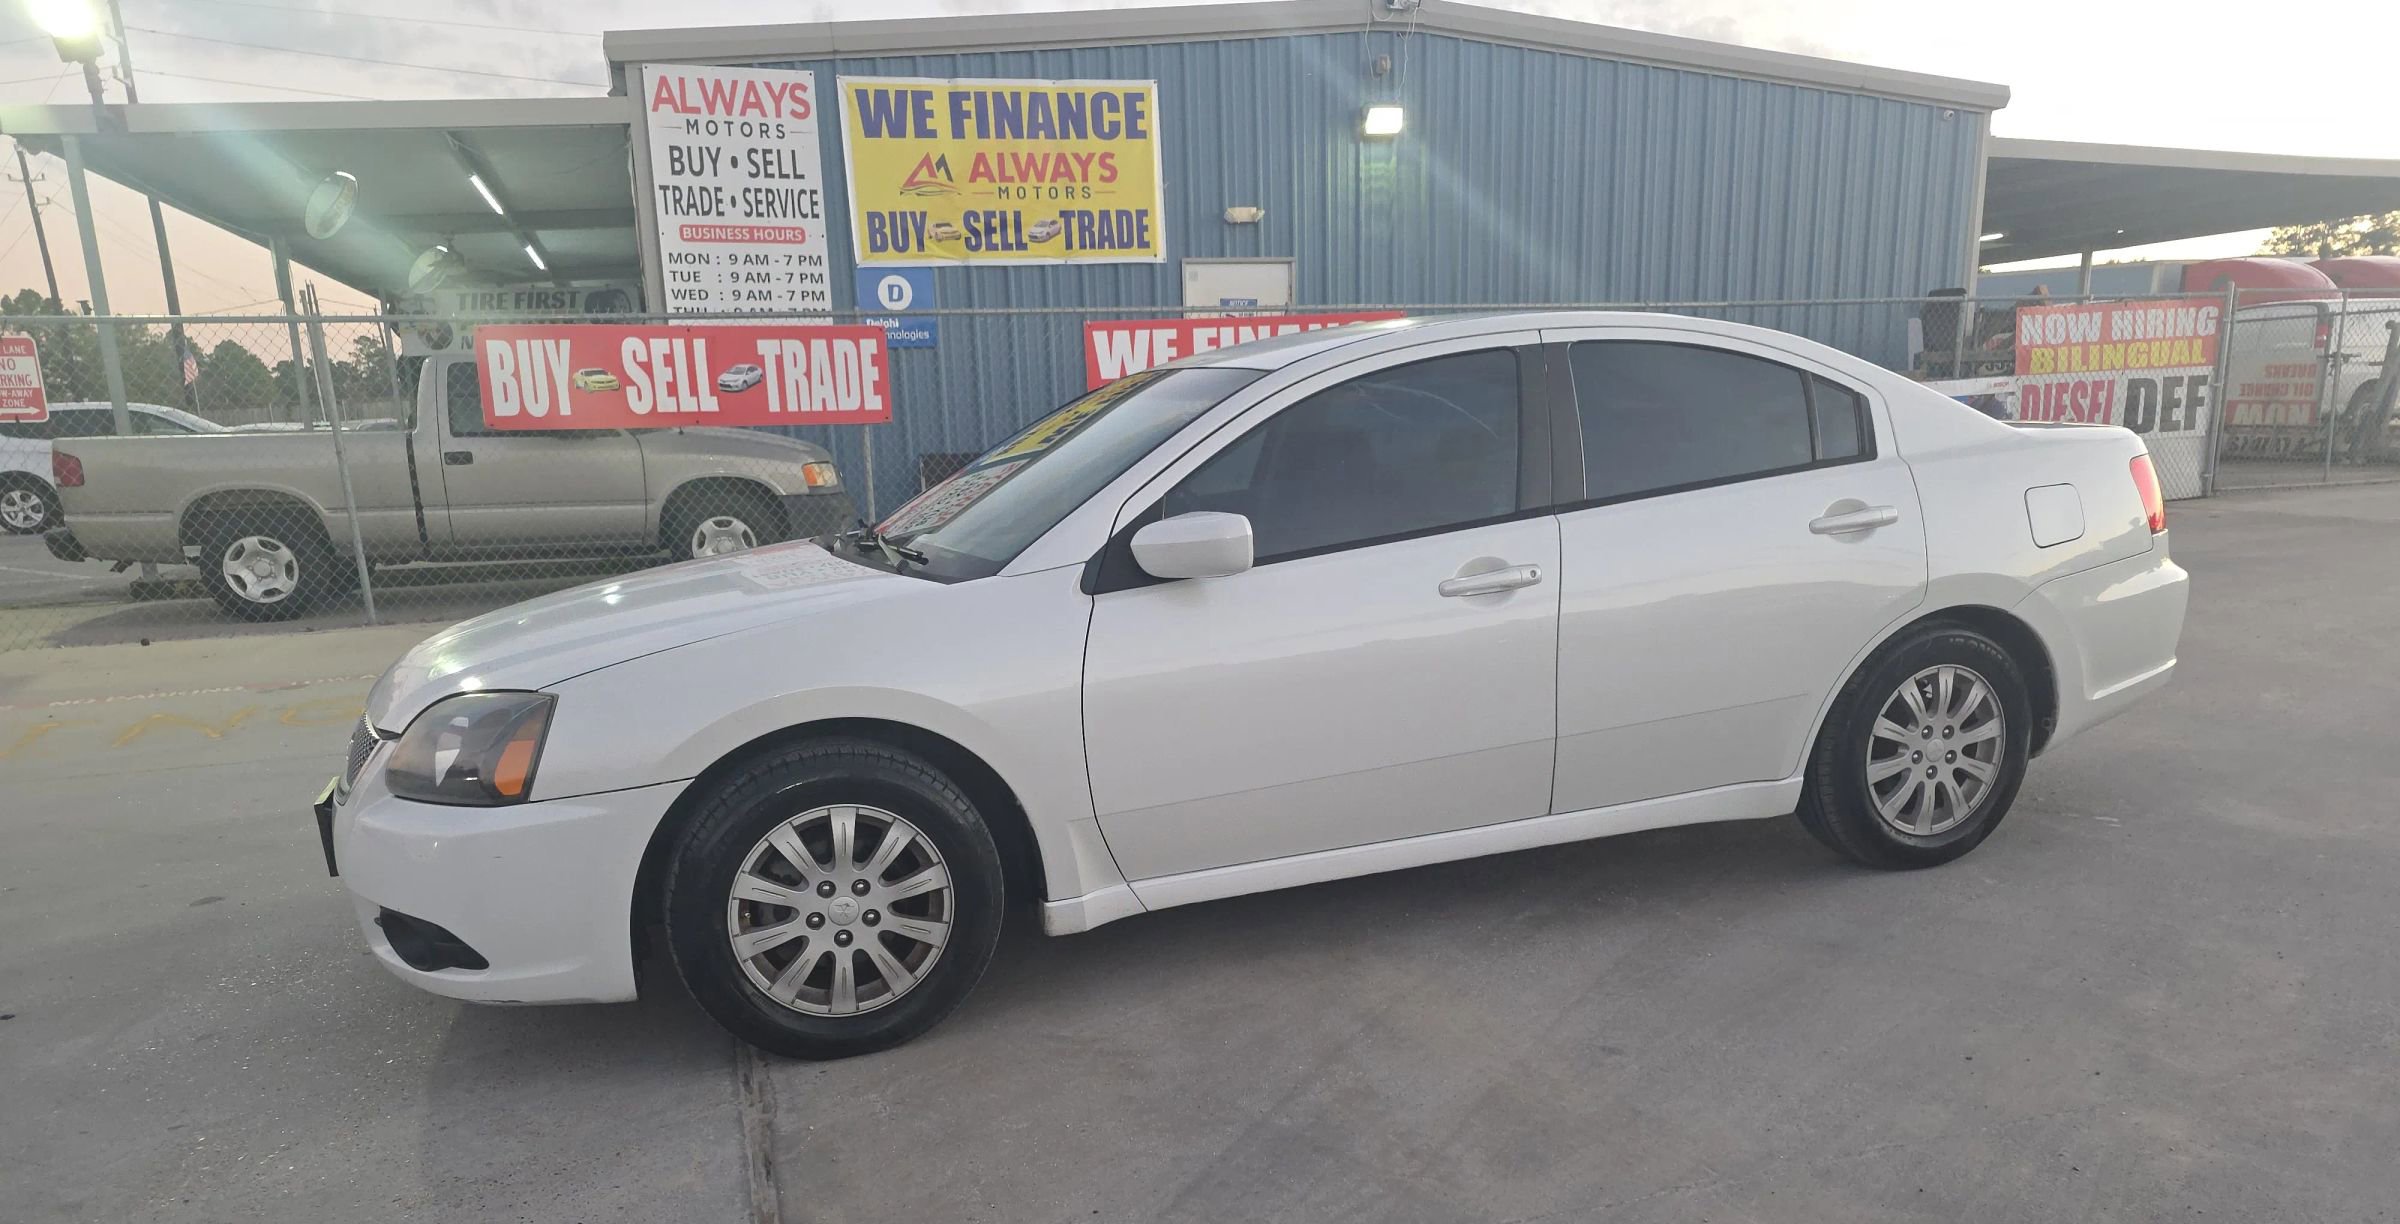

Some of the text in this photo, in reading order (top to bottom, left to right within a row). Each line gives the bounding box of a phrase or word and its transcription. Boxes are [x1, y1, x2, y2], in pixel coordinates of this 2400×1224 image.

[652, 75, 811, 120] ALWAYS
[854, 88, 1147, 140] WE FINANCE
[686, 119, 786, 139] MOTORS
[668, 145, 805, 180] BUY SELL
[968, 151, 1119, 183] ALWAYS
[658, 184, 820, 219] TRADE SERVICE
[998, 186, 1092, 200] MOTORS
[683, 227, 802, 242] BUSINESS HOURS
[866, 208, 1150, 253] BUY SELL TRADE
[668, 253, 710, 265] MON
[728, 254, 738, 265] 9
[743, 254, 769, 266] AM
[783, 254, 793, 266] 7
[798, 255, 823, 266] PM
[669, 271, 702, 283] TUE
[730, 272, 740, 283] 9
[745, 272, 771, 284] AM
[785, 273, 794, 284] 7
[800, 273, 824, 284] PM
[456, 289, 581, 311] TIRE FIRST
[671, 288, 709, 301] WED
[732, 289, 742, 301] 9
[746, 290, 772, 301] AM
[786, 290, 796, 302] 7
[801, 290, 825, 302] PM
[887, 284, 904, 303] D
[2021, 306, 2219, 346] NOW HIRING
[2, 345, 27, 354] LANE
[1092, 328, 1177, 380] WE
[2030, 338, 2207, 375] BILINGUAL
[0, 374, 33, 387] RKING
[485, 336, 882, 417] BUY SELL TRADE
[2, 399, 26, 408] ZONE
[2020, 375, 2209, 434] DIESEL DEF
